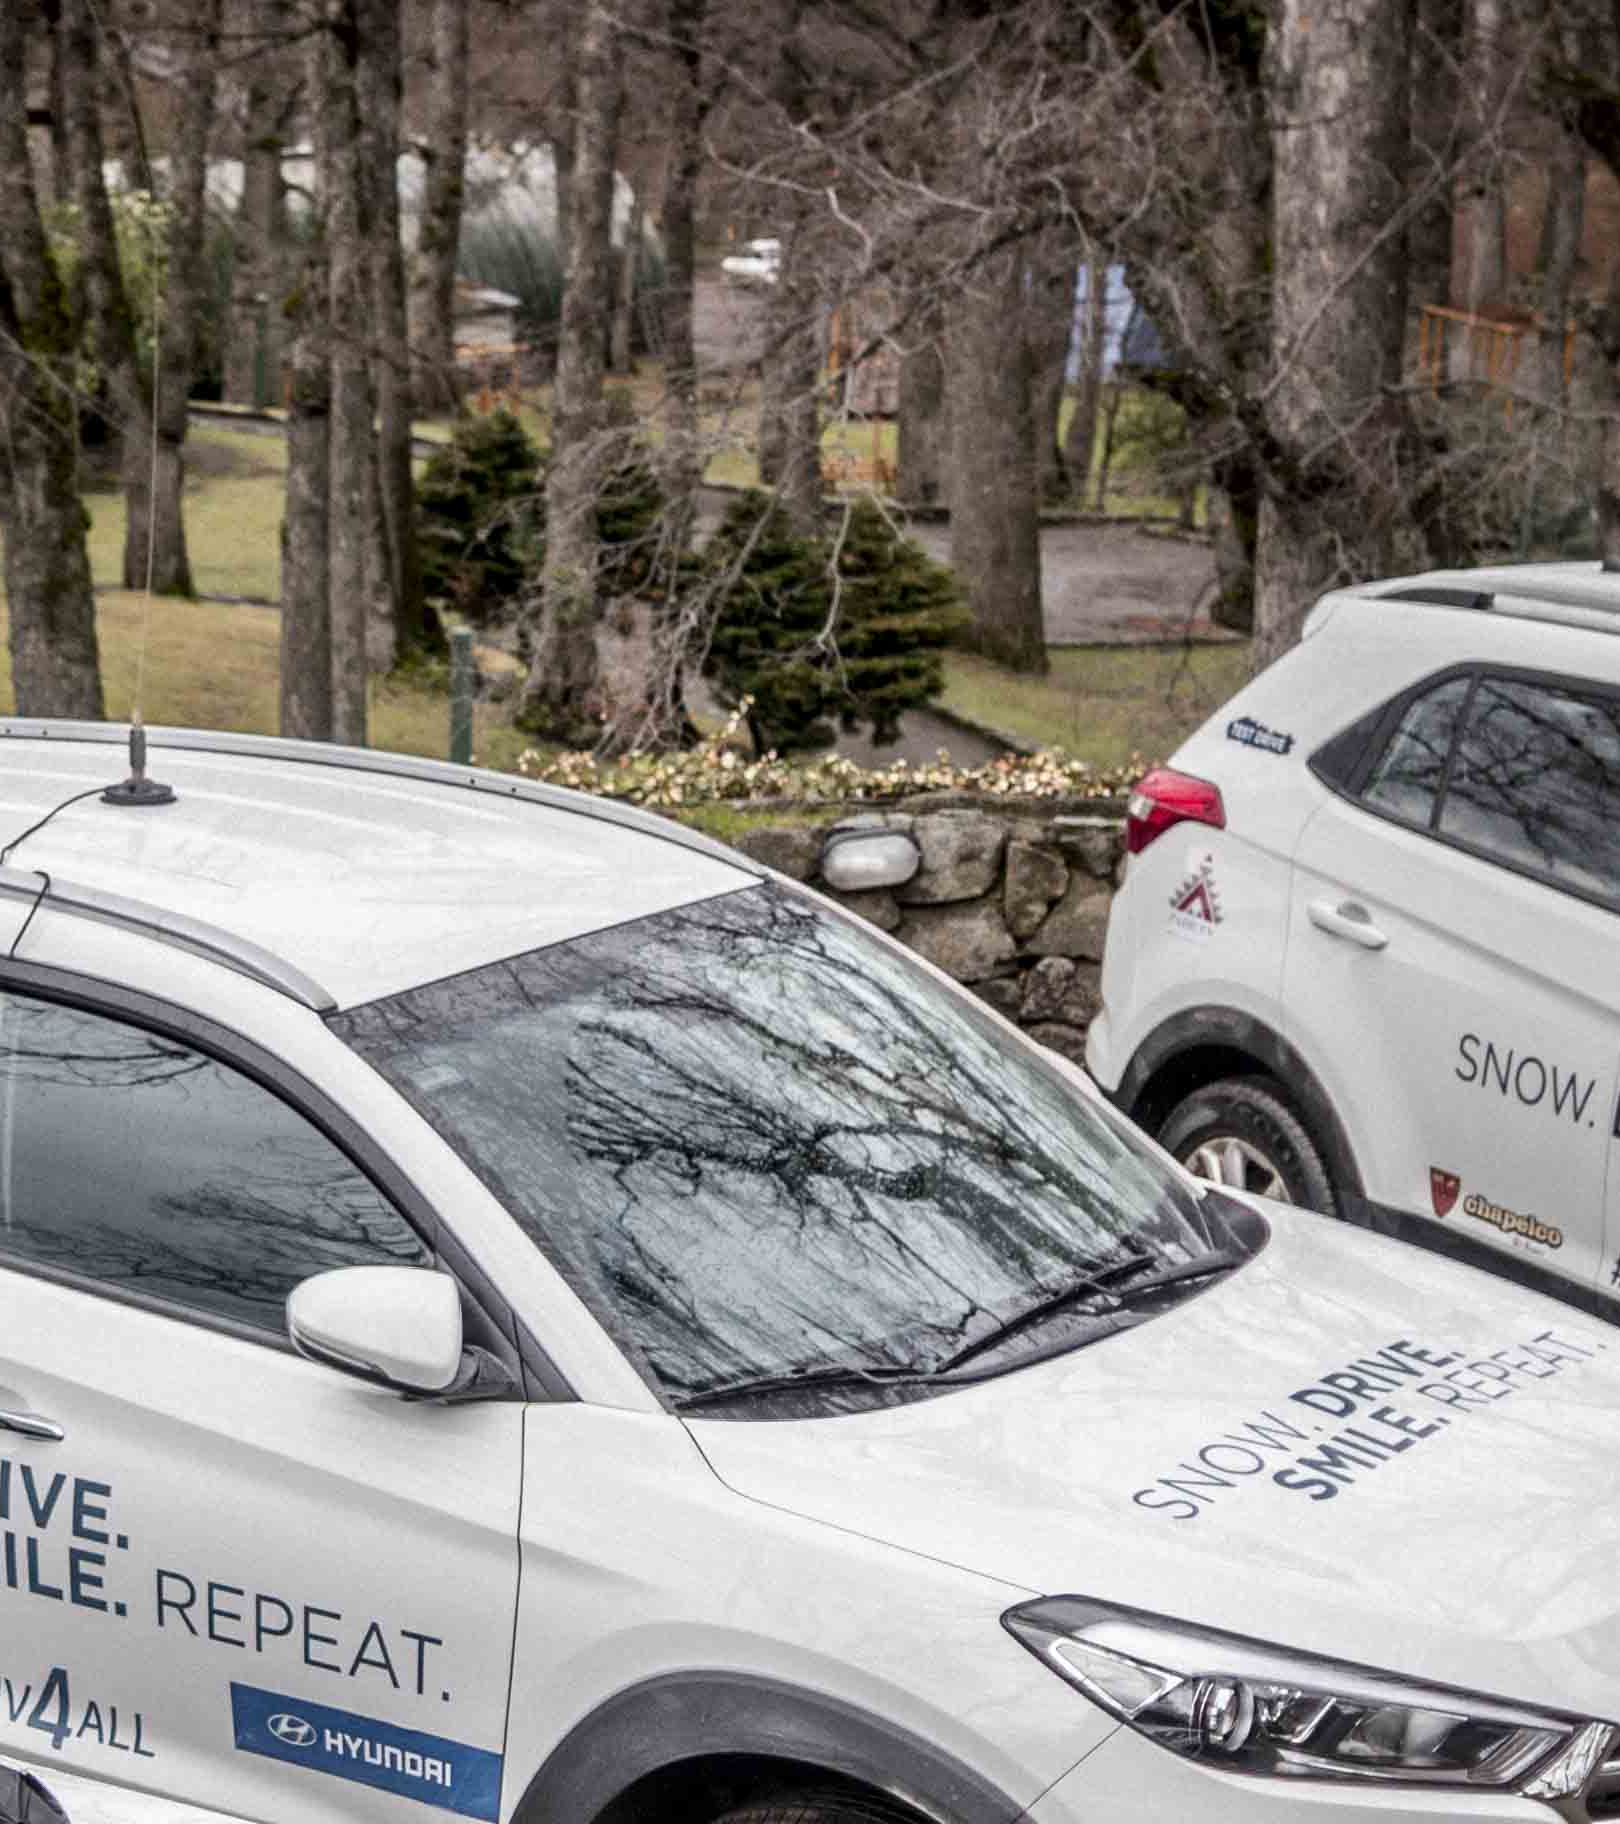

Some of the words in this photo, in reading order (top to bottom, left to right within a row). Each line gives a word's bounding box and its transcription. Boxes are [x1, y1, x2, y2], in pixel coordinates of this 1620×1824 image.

[1456, 1035, 1595, 1128] SNOW.
[1133, 1411, 1323, 1519] SNOW.
[1288, 1341, 1464, 1418] DRIVE.
[1272, 1408, 1450, 1500] SMILE.
[1416, 1331, 1606, 1413] REPEAT.
[157, 1569, 449, 1701] REPEAT.
[325, 1729, 451, 1787] HYUNDAI
